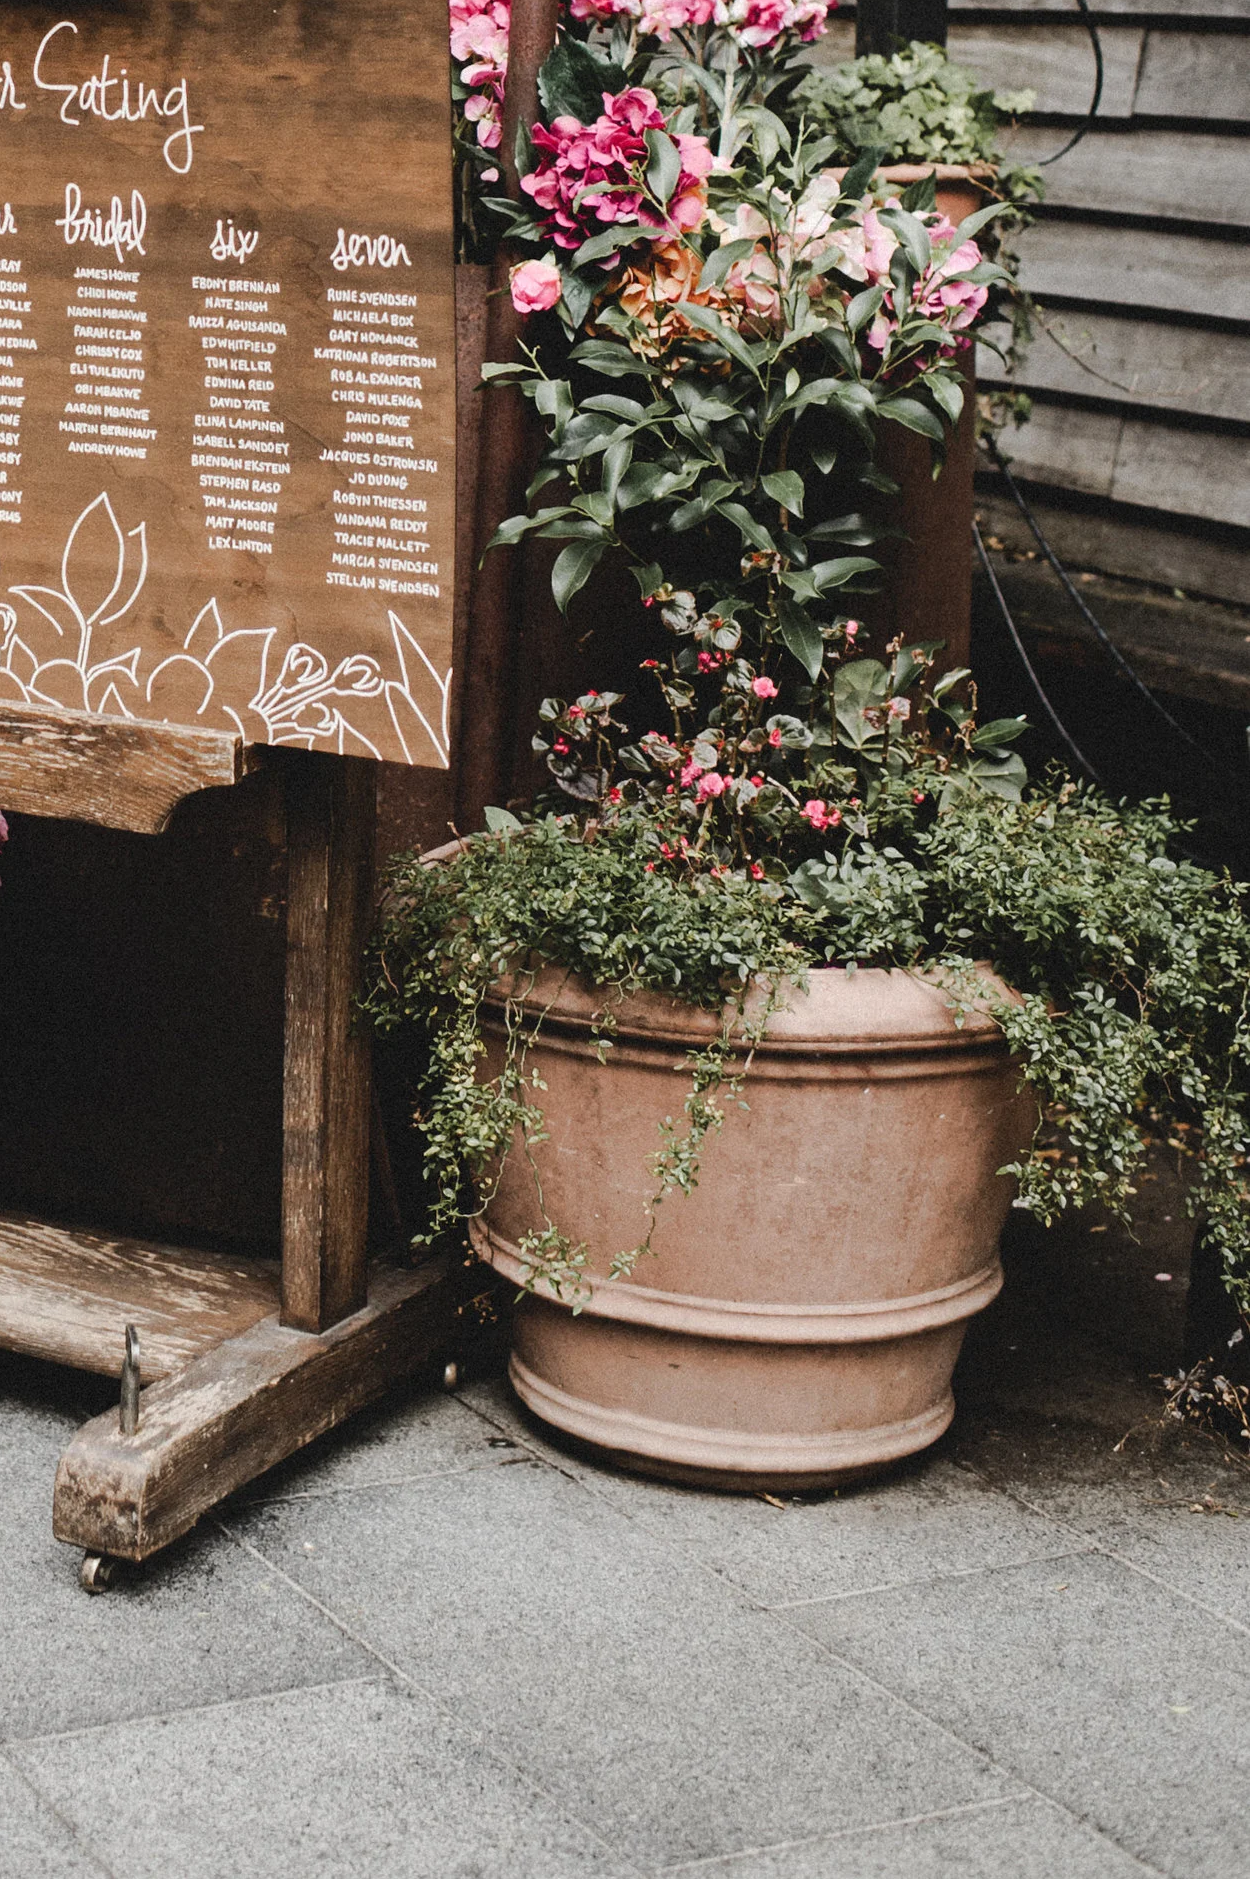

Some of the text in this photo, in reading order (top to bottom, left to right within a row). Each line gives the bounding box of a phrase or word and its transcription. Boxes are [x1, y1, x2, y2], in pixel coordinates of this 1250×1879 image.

[33, 21, 204, 174] Eating
[55, 183, 147, 263] bridal
[209, 219, 258, 264] six
[330, 228, 411, 271] seven
[74, 267, 140, 282] JAMES HOWE
[192, 276, 280, 293] EBONY BRENNAN
[107, 289, 137, 302] HOWE
[327, 288, 417, 307] RUNE SVENDSEN
[68, 306, 101, 318] NAOMI
[205, 297, 268, 312] NATE SINGH
[333, 309, 414, 327] MICHAELA BOX
[74, 325, 108, 339] FARAH
[329, 330, 359, 342] GARY
[75, 345, 142, 361] CHRISSY COX
[202, 337, 276, 353] ED WHITFIELD
[204, 357, 272, 373] TOM KELLER
[314, 348, 436, 368] KATRIONA ROBERTSON
[70, 363, 87, 375] ELI
[205, 376, 274, 391] EDWINA REID
[331, 369, 422, 389] ROB ALEXANDER
[210, 396, 270, 412] DAVID TATE
[332, 390, 422, 409] CHRIS MULENGA
[65, 402, 102, 415] AARON
[59, 421, 99, 434] MARTIN
[195, 415, 284, 433] ELINA LAMPINEN
[346, 411, 410, 427] DAVID FOXE
[193, 435, 236, 448] ISABELL
[342, 432, 414, 449] JONO BAKER
[68, 442, 147, 459] ANDREW HOWE
[191, 454, 290, 474] BRENDAN EKSTEIN
[319, 449, 438, 472] JACQUES OSTROWSKI
[200, 474, 281, 493] STEPHEN RASO
[349, 473, 409, 489] JO DUONG
[203, 495, 277, 513] TAM JACKSON
[333, 490, 427, 512] ROBYN THIESSEN
[206, 515, 275, 533] MATT MOORE
[334, 513, 428, 533] VANDANA REDDY
[209, 536, 272, 553] LEX LINTON
[334, 532, 430, 552] TRACIE MALLETT
[332, 553, 438, 575] MARCIA SVENDSEN
[326, 572, 439, 598] STELLAN SVENDSEN
